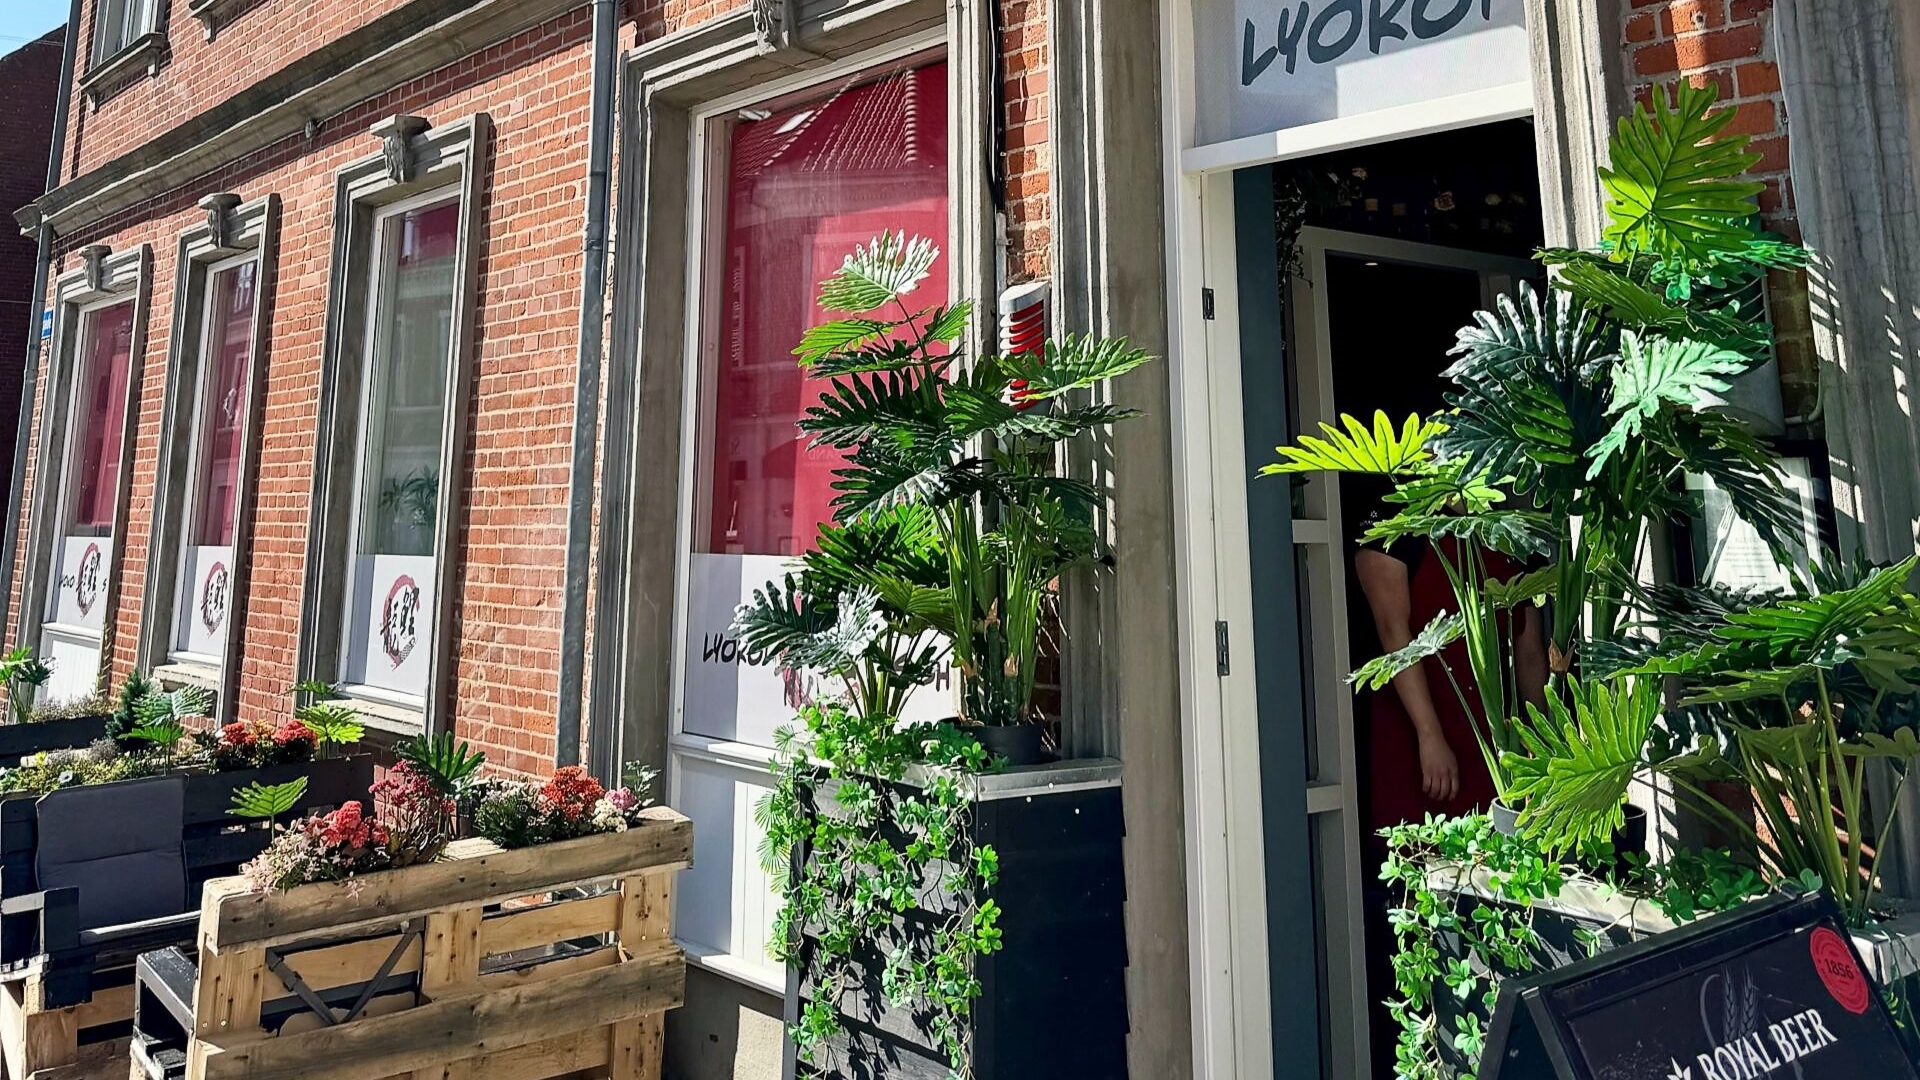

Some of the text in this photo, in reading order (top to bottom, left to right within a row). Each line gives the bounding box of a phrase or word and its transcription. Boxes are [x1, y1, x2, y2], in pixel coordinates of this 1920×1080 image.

[1824, 958, 1855, 980] 1856
[1696, 1008, 1839, 1080] ROYAL BEER
